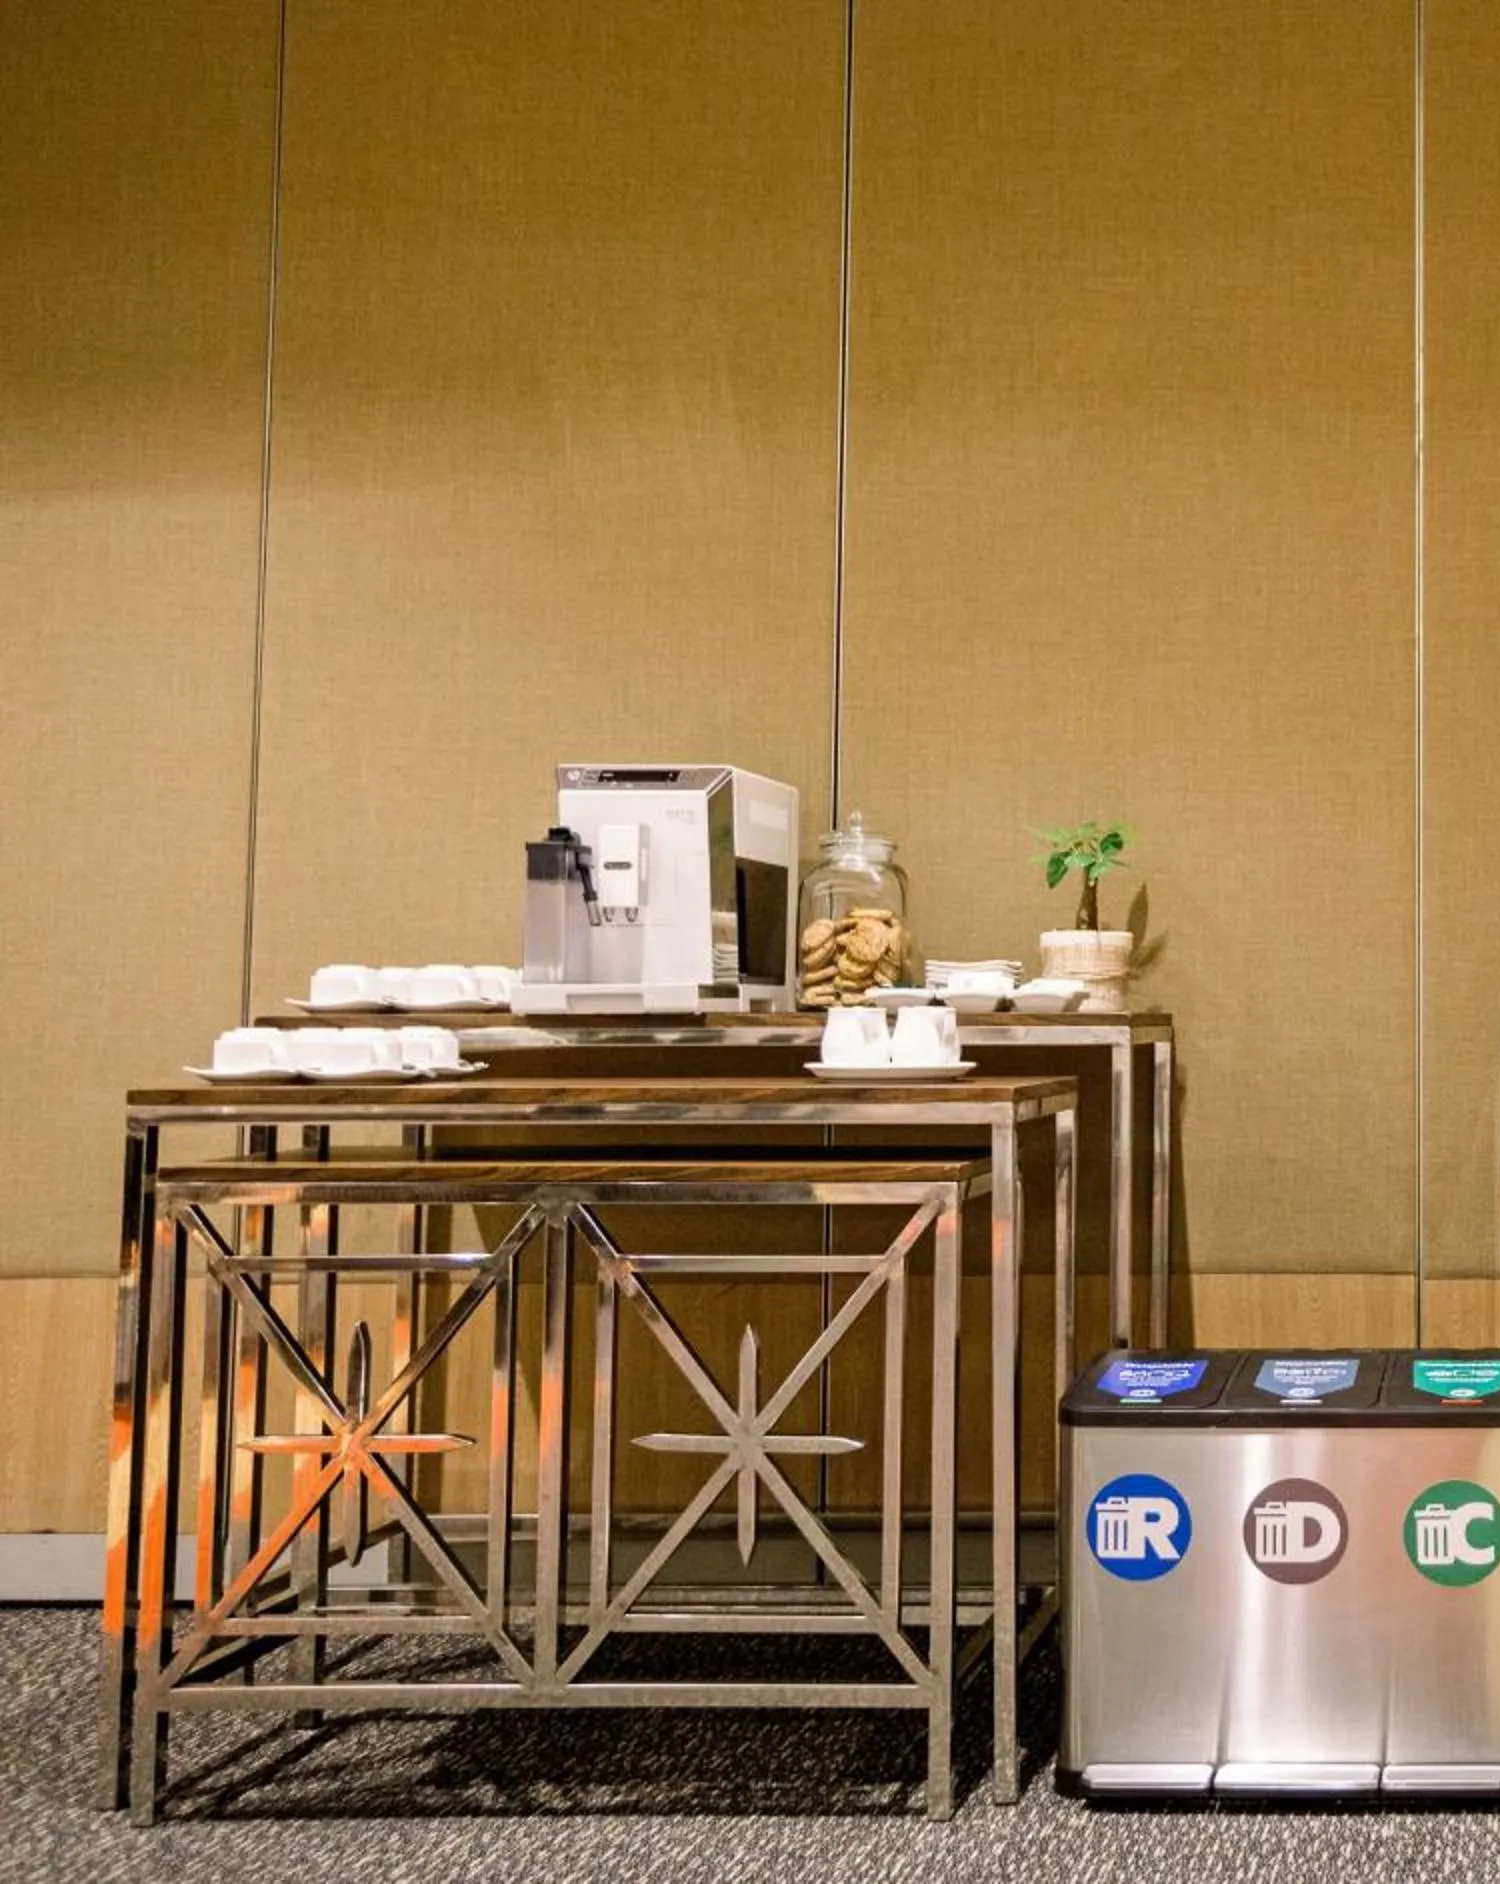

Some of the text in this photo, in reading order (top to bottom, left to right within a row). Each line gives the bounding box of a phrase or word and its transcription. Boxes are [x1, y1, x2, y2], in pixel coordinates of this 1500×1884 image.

[1129, 1497, 1180, 1560] R
[1287, 1501, 1341, 1563] D
[1455, 1502, 1494, 1565] C
